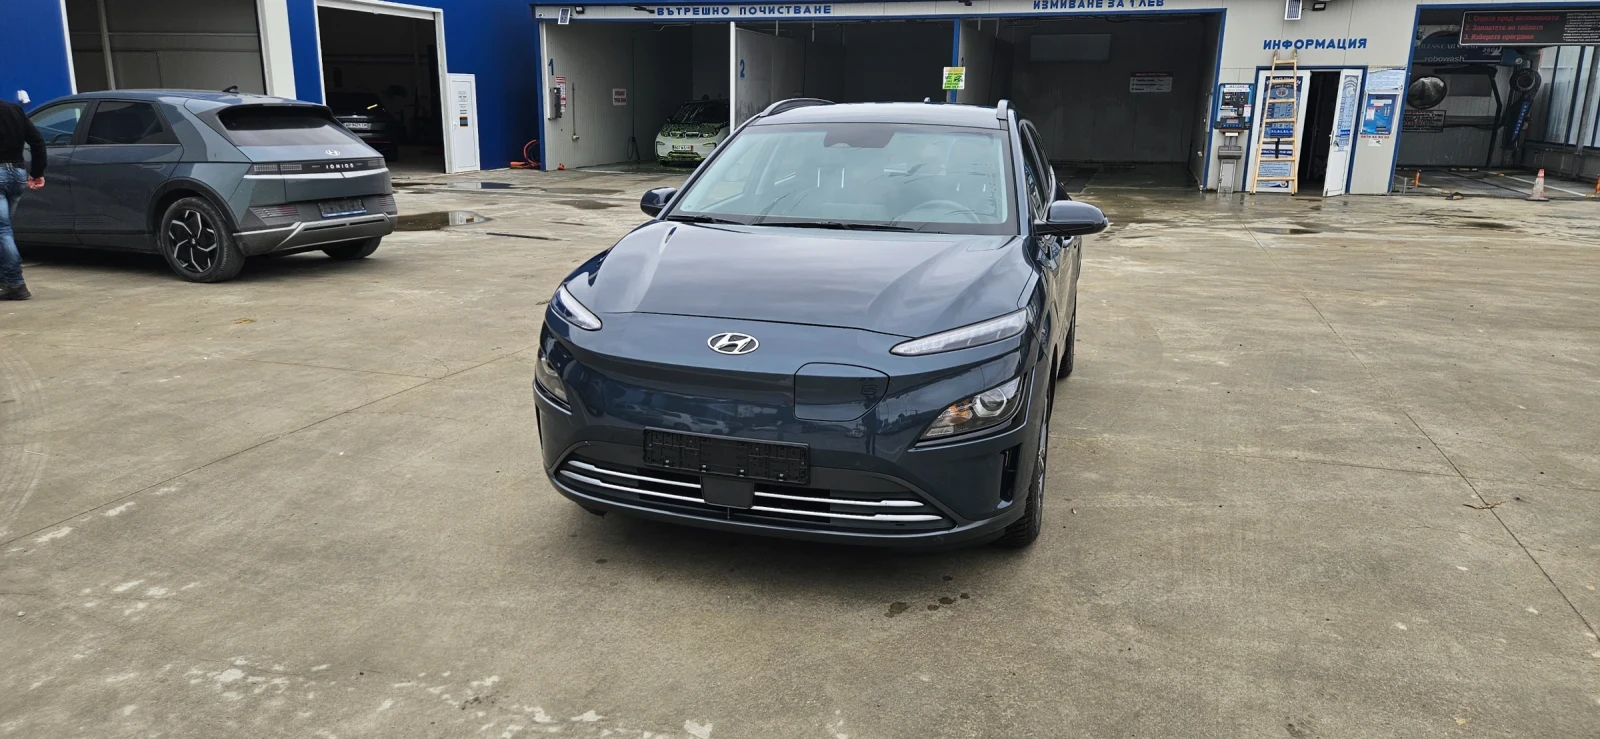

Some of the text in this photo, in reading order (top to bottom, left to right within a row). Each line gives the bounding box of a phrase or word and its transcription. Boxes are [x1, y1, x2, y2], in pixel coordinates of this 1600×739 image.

[656, 5, 832, 16] ВЪТРЕШНО ПОЧИСТВАНЕ
[1033, 0, 1103, 9] ИЗМИВАНЕ
[1108, 0, 1124, 8] ЗА
[1263, 38, 1367, 50] ИНФОРМАЦИЯ
[548, 58, 554, 76] 1
[739, 58, 745, 78] 2
